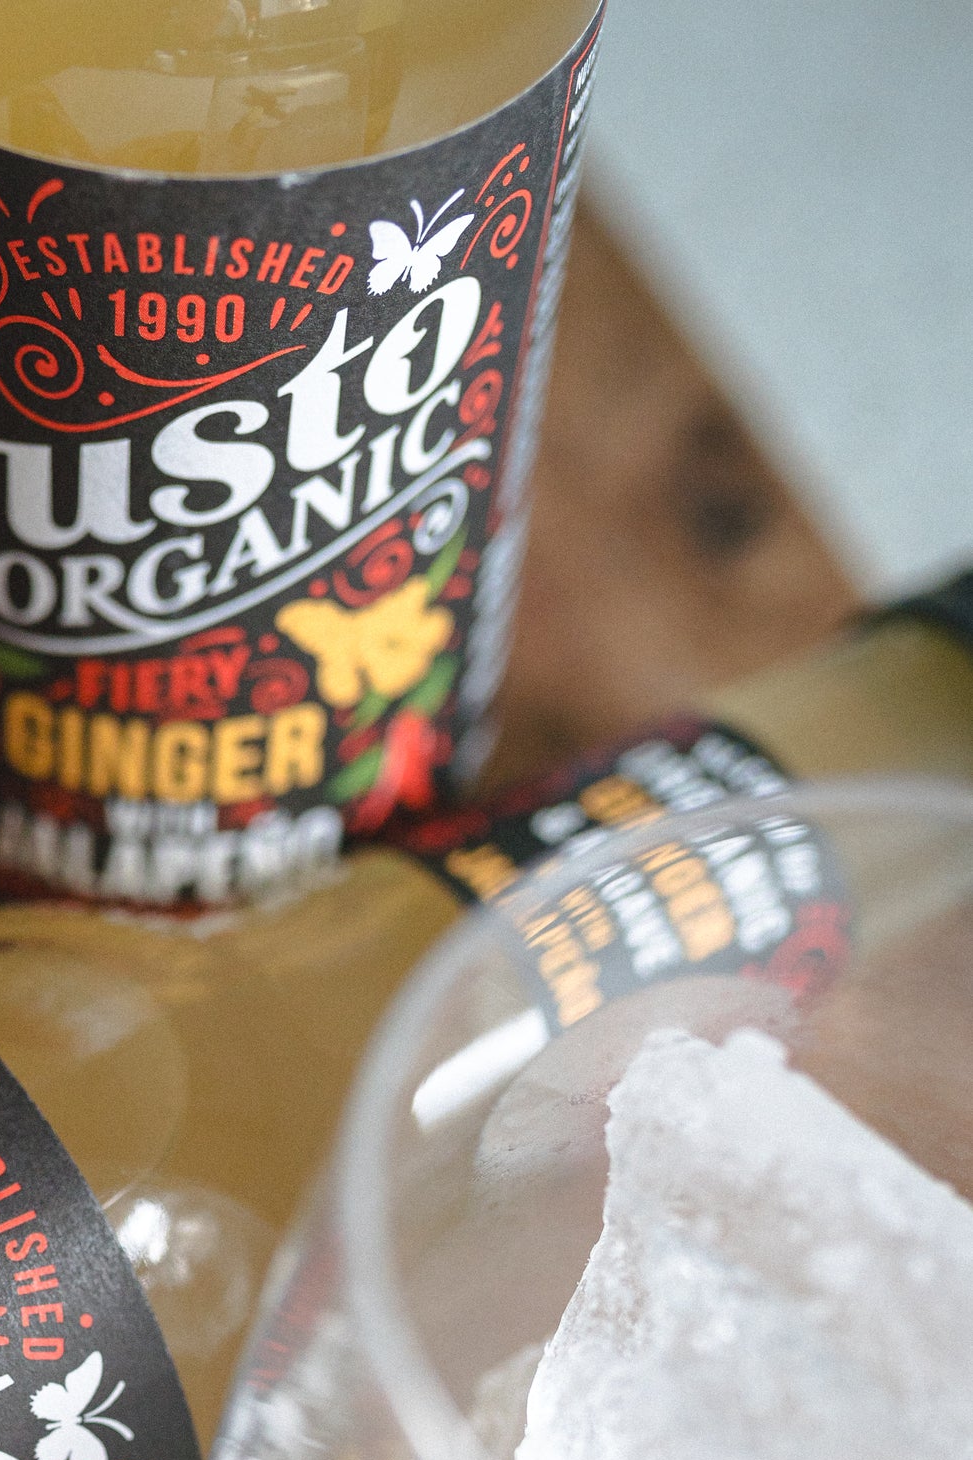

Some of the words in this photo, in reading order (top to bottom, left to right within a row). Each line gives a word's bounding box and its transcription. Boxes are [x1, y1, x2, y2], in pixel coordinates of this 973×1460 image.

[7, 232, 356, 297] ESTABLISHED
[107, 288, 246, 343] 1990
[75, 645, 253, 713] FIERY
[2, 690, 327, 804] GINGER
